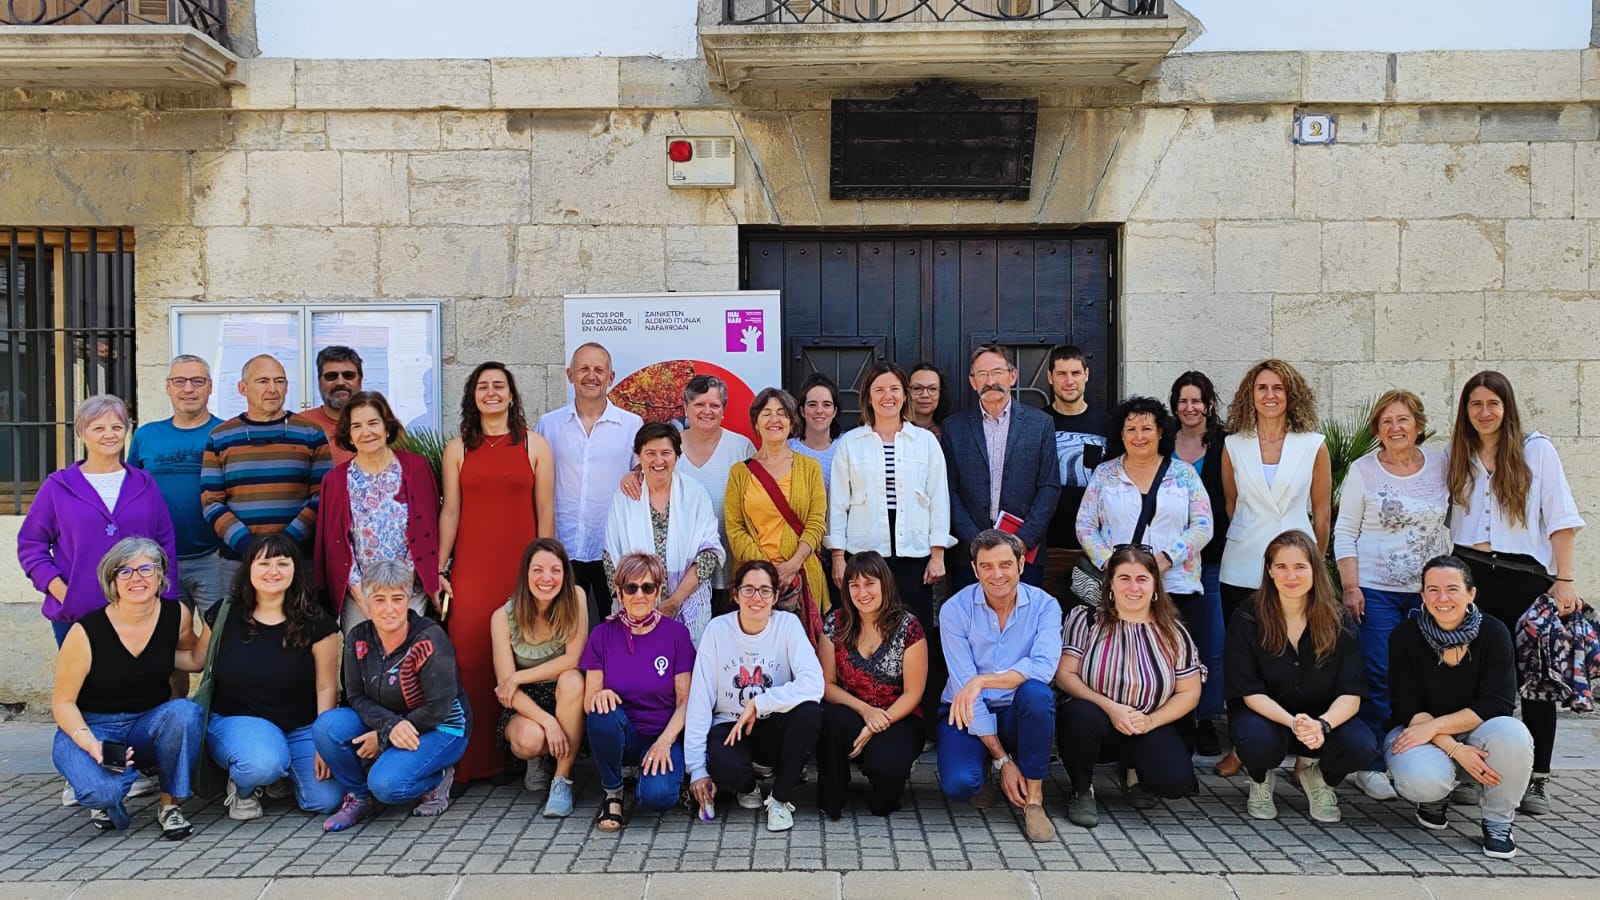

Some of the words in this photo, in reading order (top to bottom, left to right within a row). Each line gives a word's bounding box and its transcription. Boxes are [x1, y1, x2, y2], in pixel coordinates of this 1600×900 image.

[1309, 121, 1323, 136] 2
[581, 311, 609, 319] PACTOS
[723, 656, 780, 672] HERITAGE
[725, 691, 734, 699] 19
